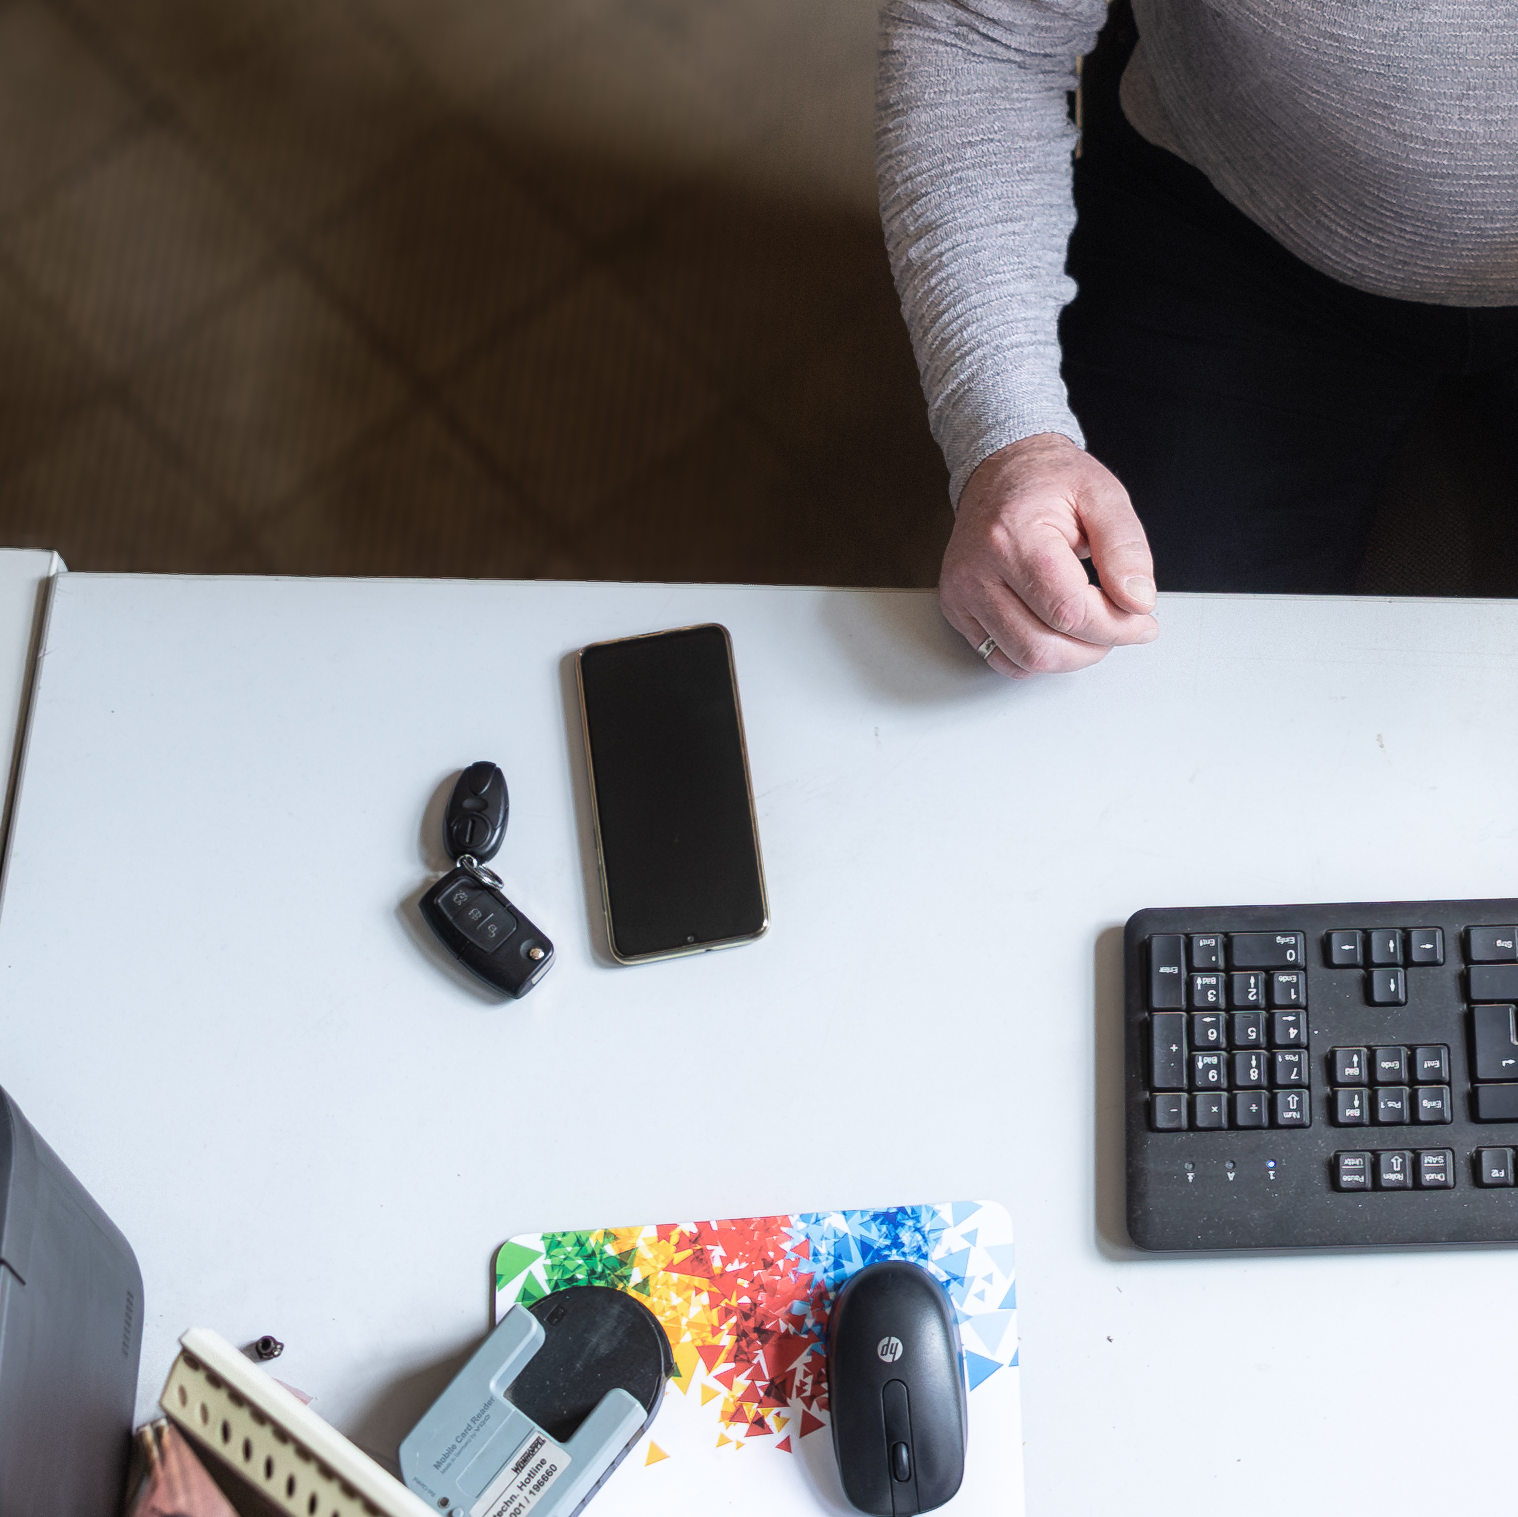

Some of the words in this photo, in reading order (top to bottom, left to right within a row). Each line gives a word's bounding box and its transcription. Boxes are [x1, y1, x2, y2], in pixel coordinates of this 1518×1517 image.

[1287, 950, 1295, 961] 0
[1208, 990, 1216, 1001] 3
[1248, 989, 1256, 1000] 2
[1208, 1029, 1217, 1040] 6
[1248, 1027, 1256, 1039] 5
[1289, 1027, 1298, 1038] 4
[1209, 1070, 1217, 1081] 9
[1250, 1068, 1258, 1080] 8
[1291, 1068, 1299, 1079] 7
[432, 1442, 457, 1470] Mobile
[454, 1423, 473, 1443] Card
[470, 1395, 496, 1424] Reader
[516, 1458, 547, 1491] Hotline
[528, 1463, 558, 1497] 196660
